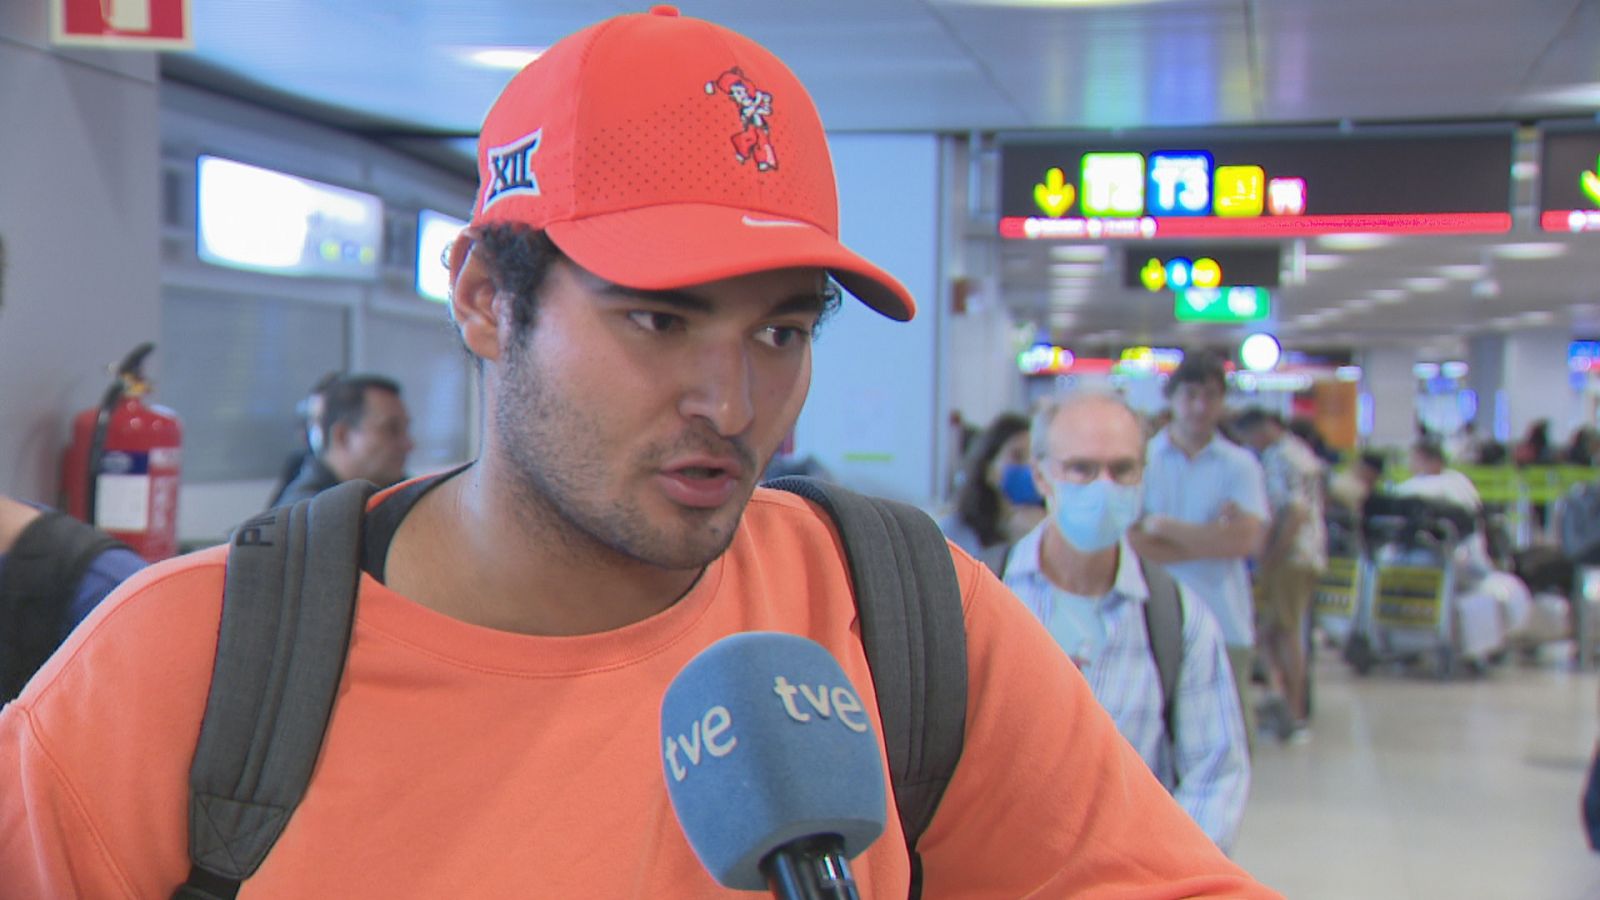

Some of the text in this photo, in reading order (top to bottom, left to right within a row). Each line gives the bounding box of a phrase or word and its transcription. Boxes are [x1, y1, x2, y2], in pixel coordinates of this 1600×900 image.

[487, 137, 538, 203] XII
[1151, 165, 1209, 211] T3
[774, 676, 867, 732] tve
[665, 705, 738, 781] tve
